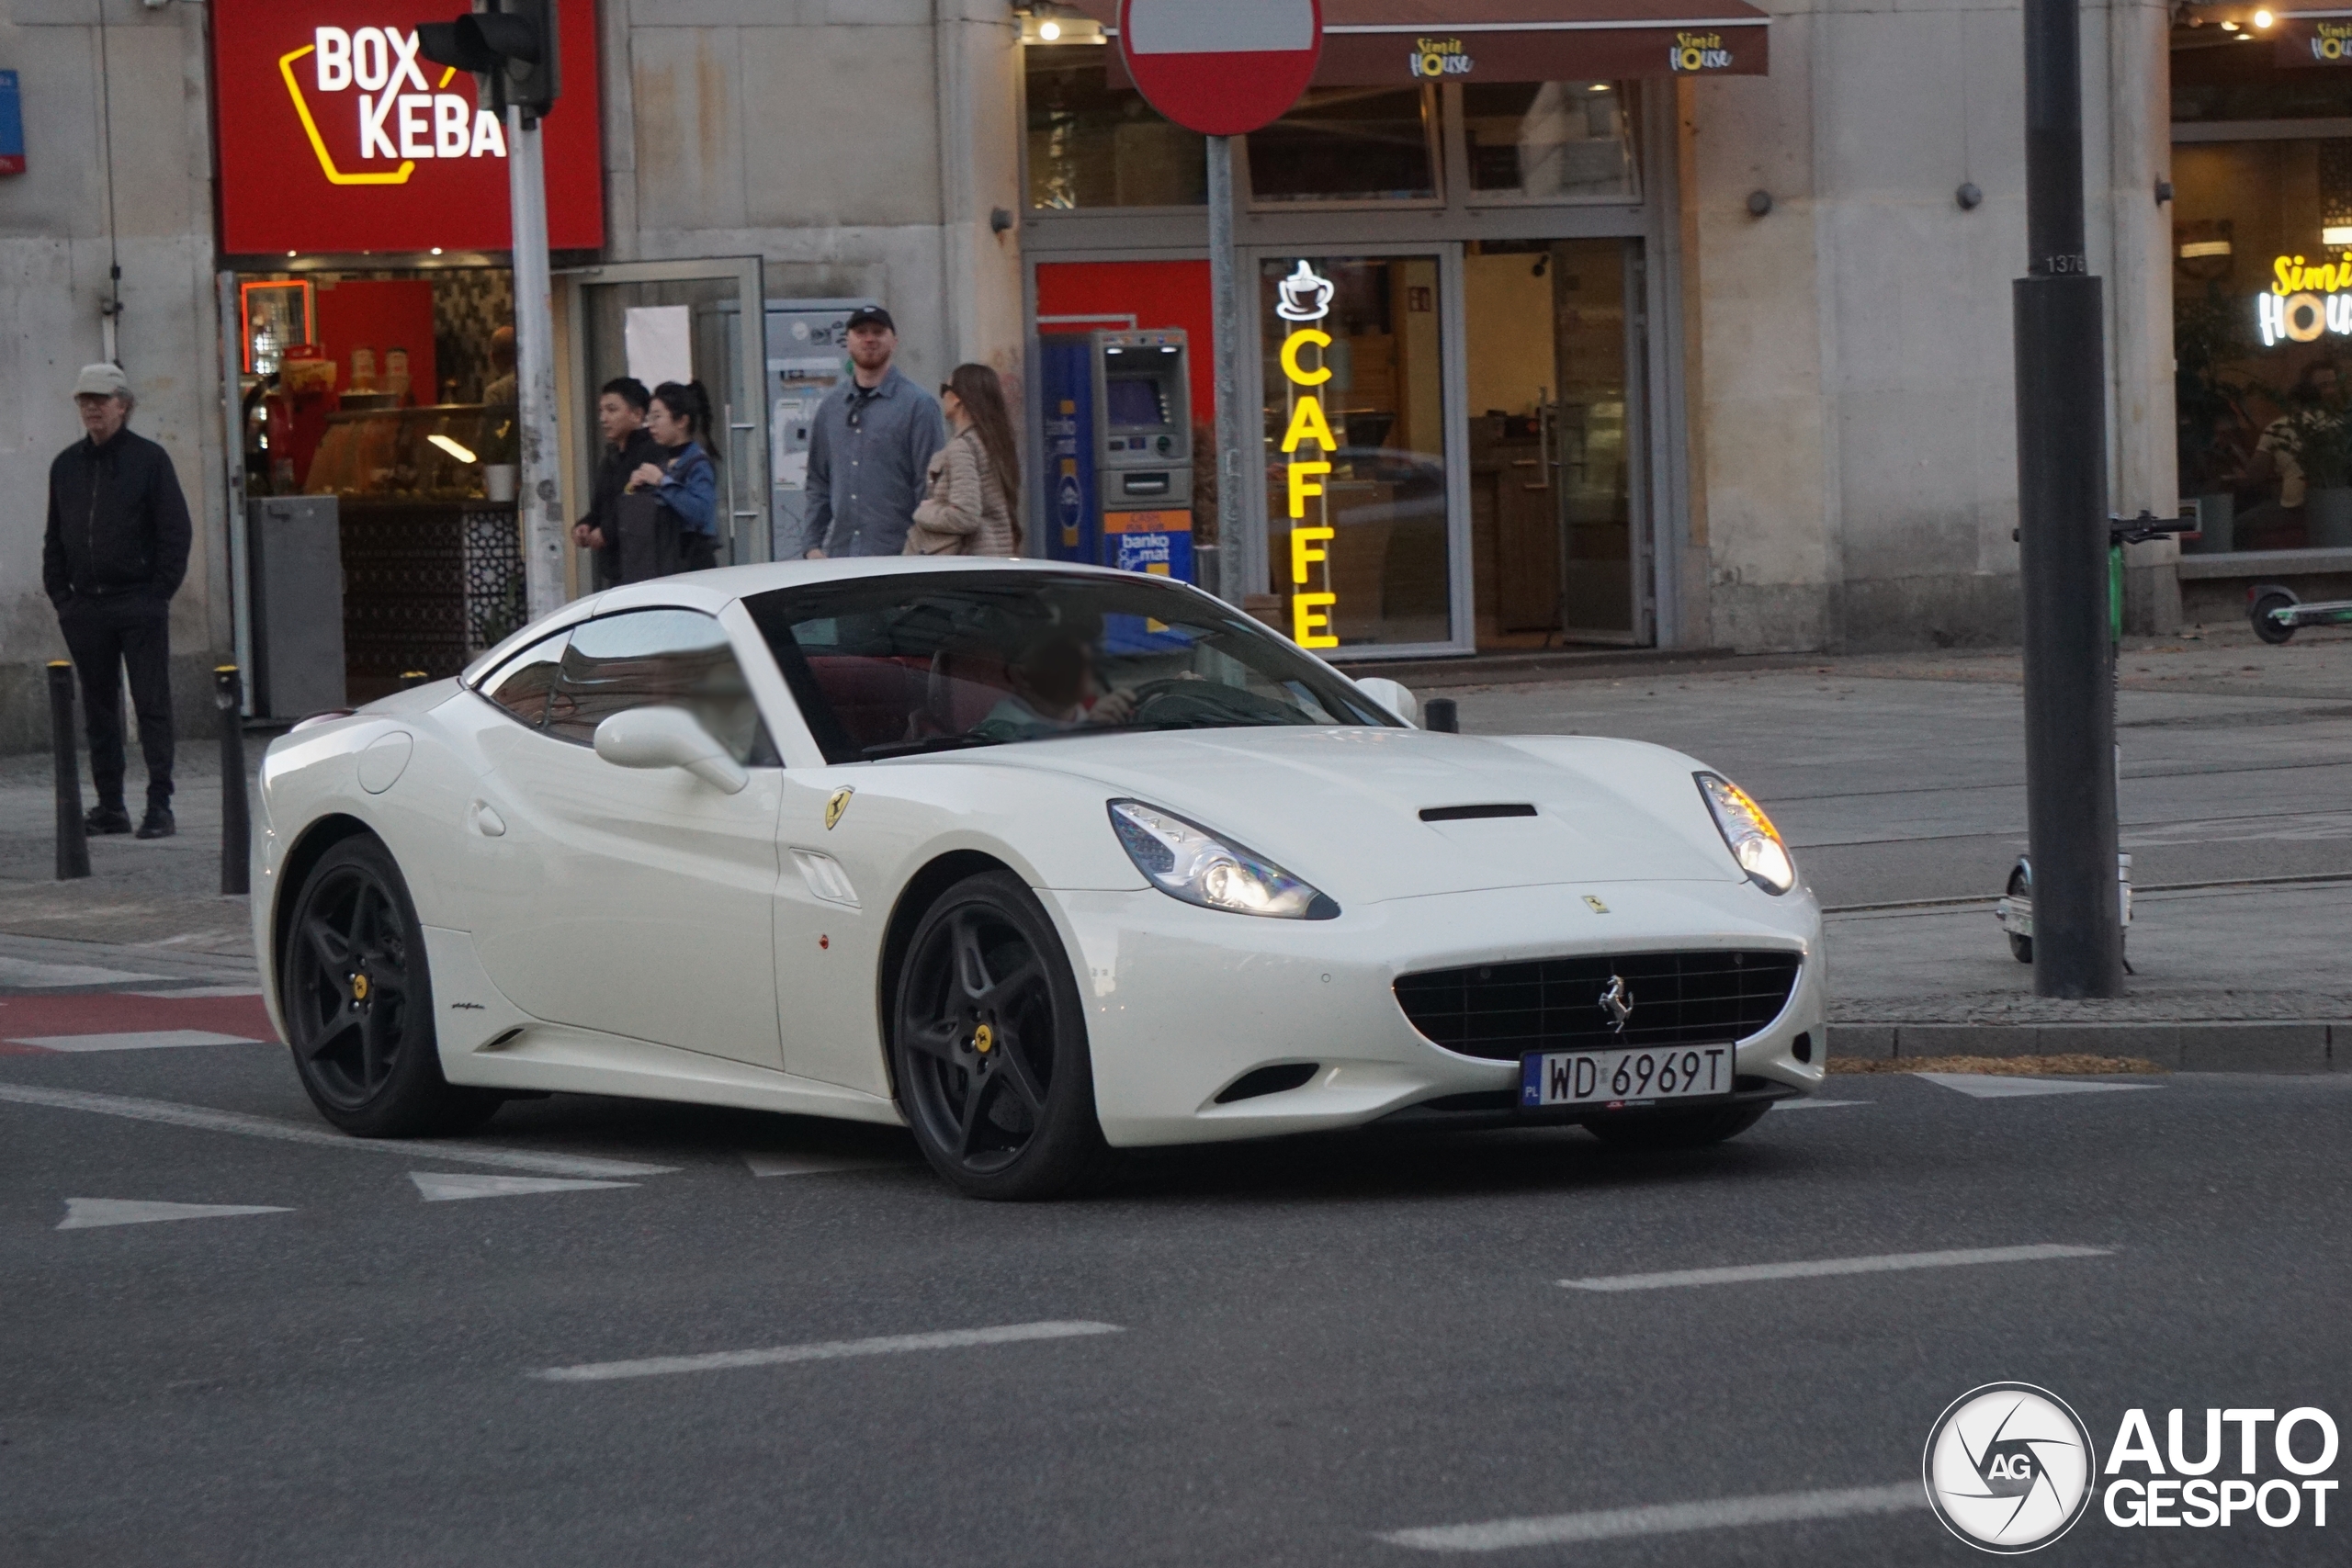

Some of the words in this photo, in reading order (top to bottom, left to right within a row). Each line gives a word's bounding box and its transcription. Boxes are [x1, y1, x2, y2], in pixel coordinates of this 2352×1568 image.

[2317, 23, 2352, 38] Simi
[315, 27, 429, 91] BOX
[359, 94, 507, 159] KEBA
[2272, 252, 2352, 296] Simi
[1280, 329, 1339, 649] CAFFE
[1122, 534, 1170, 548] banko
[1140, 548, 1169, 560] mat
[1525, 1086, 1538, 1097] PL
[1550, 1057, 1596, 1100] WD
[1612, 1049, 1724, 1096] 6969T
